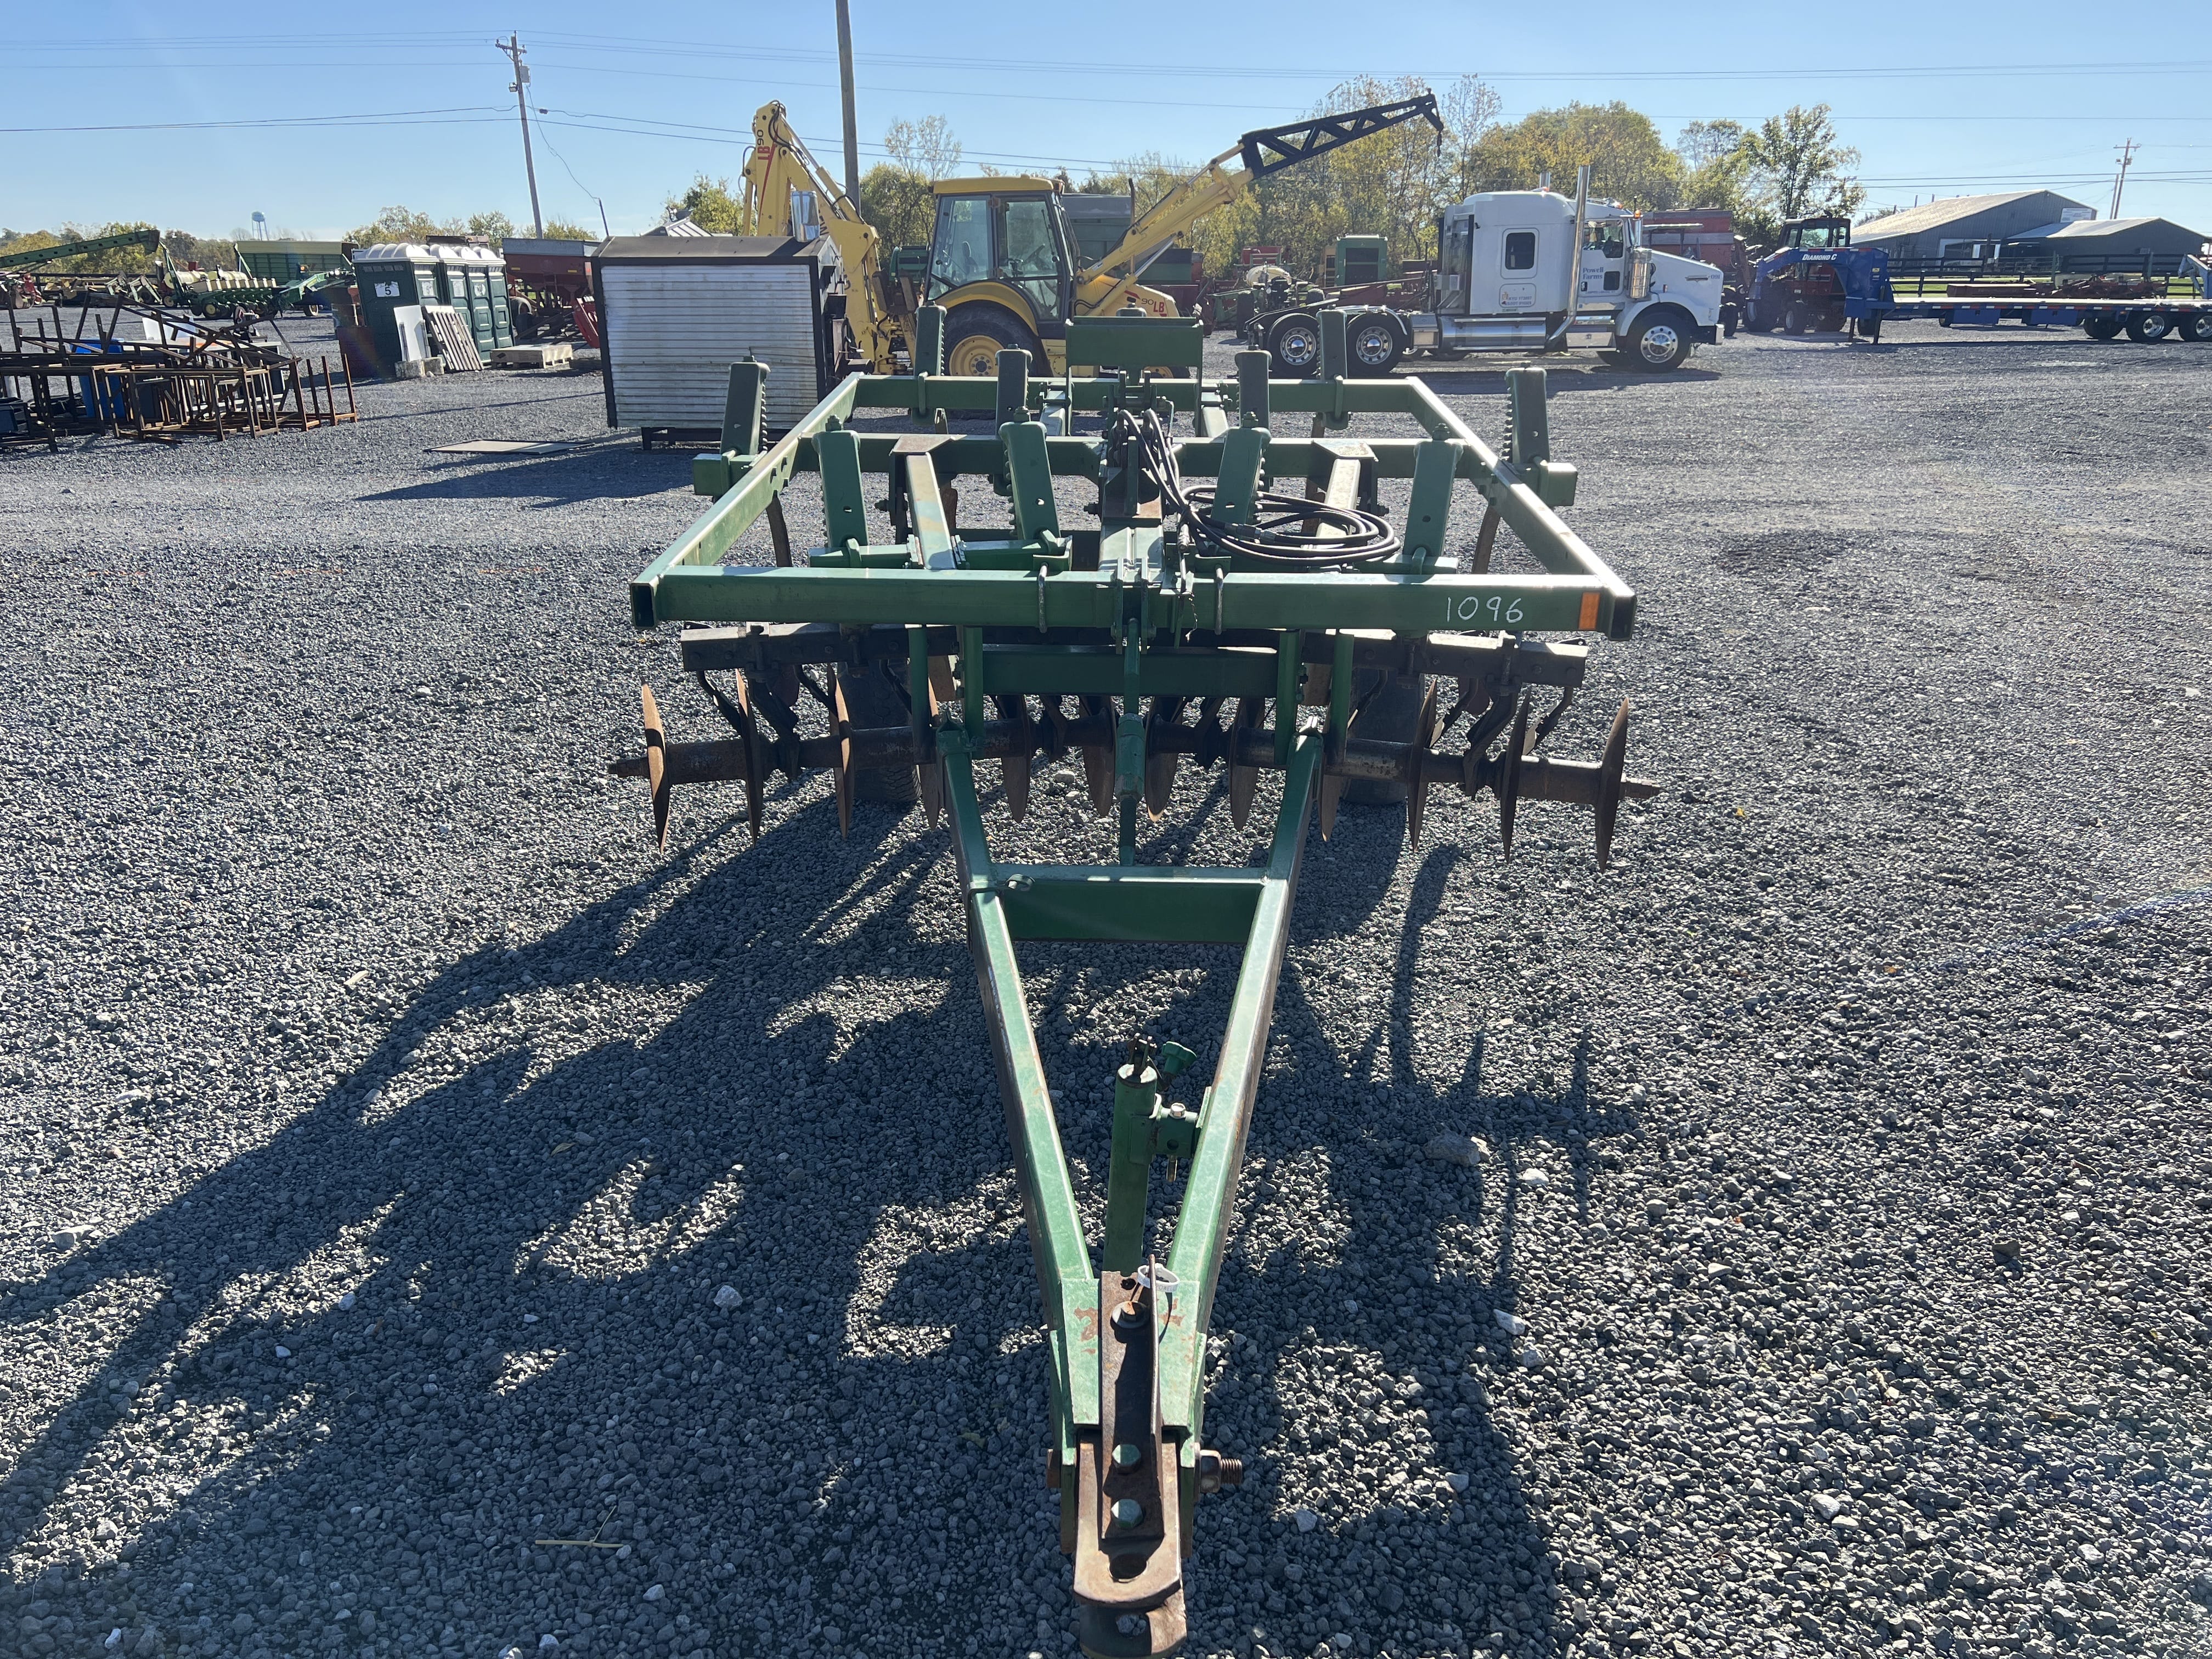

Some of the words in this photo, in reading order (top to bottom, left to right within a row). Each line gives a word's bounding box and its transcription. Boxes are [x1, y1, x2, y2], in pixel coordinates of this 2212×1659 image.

[385, 287, 391, 295] 5
[1153, 301, 1164, 312] LB
[1447, 596, 1523, 623] 1096
